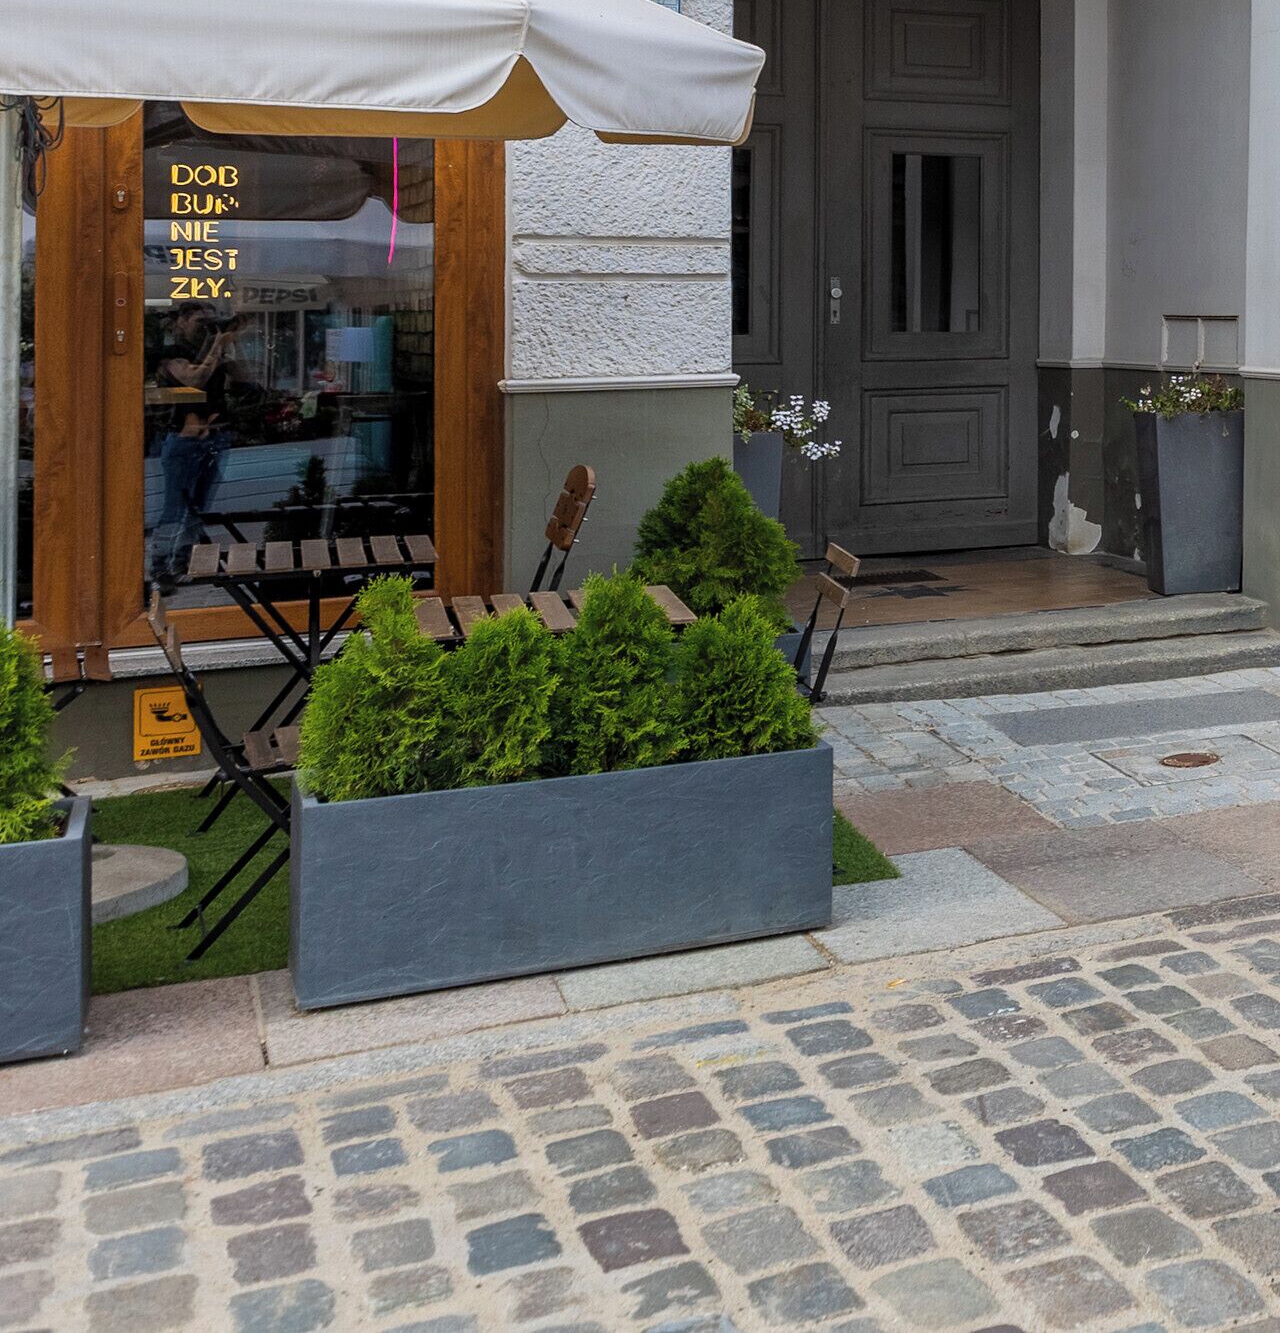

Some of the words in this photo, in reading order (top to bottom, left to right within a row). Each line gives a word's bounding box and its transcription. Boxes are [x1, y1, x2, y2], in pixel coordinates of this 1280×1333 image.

[169, 221, 220, 243] NIE
[169, 248, 239, 271] JEST
[242, 286, 317, 305] PEPSI
[140, 748, 170, 756] ZAWÓR
[173, 745, 195, 753] GAZU
[150, 737, 185, 746] GŁÓWNY
